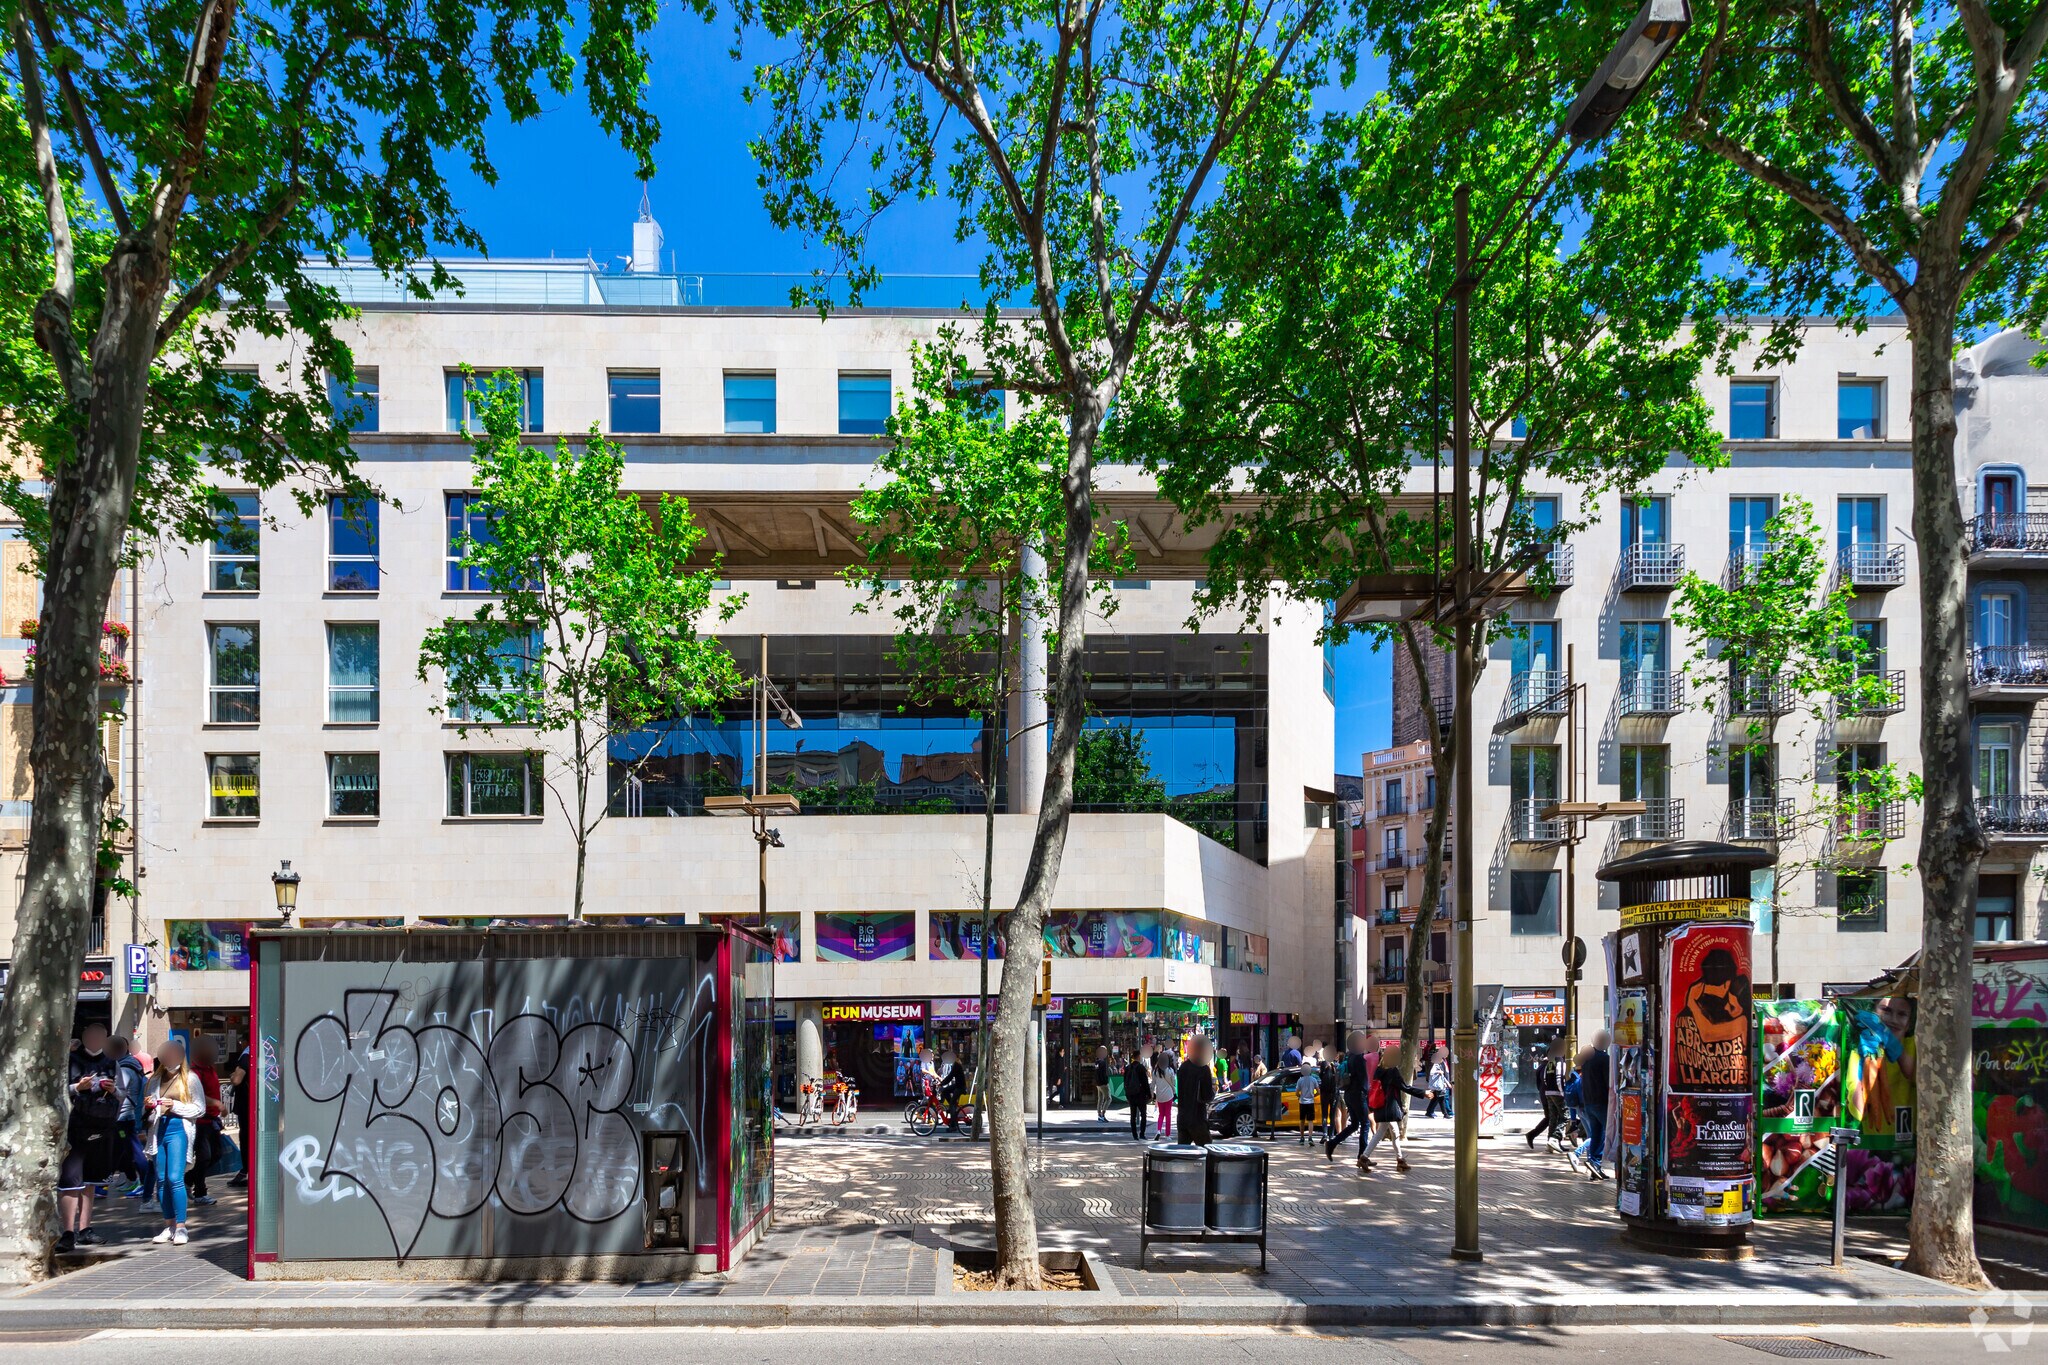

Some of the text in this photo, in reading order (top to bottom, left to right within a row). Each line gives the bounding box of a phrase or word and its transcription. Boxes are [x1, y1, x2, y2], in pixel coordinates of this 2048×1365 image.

[858, 926, 874, 934] BIG
[1092, 923, 1107, 932] BIG
[225, 934, 241, 943] BIG
[858, 935, 874, 943] FUN
[225, 943, 241, 951] FUN
[131, 948, 145, 973] P
[1688, 949, 1700, 972] D'IVAN
[861, 1005, 921, 1019] MUSEUM
[1519, 1014, 1535, 1024] 318
[1538, 1014, 1549, 1024] 36
[1552, 1014, 1563, 1024] 63
[1680, 1065, 1748, 1085] LLARGUES
[1800, 1093, 1812, 1117] R
[1900, 1109, 1910, 1133] R
